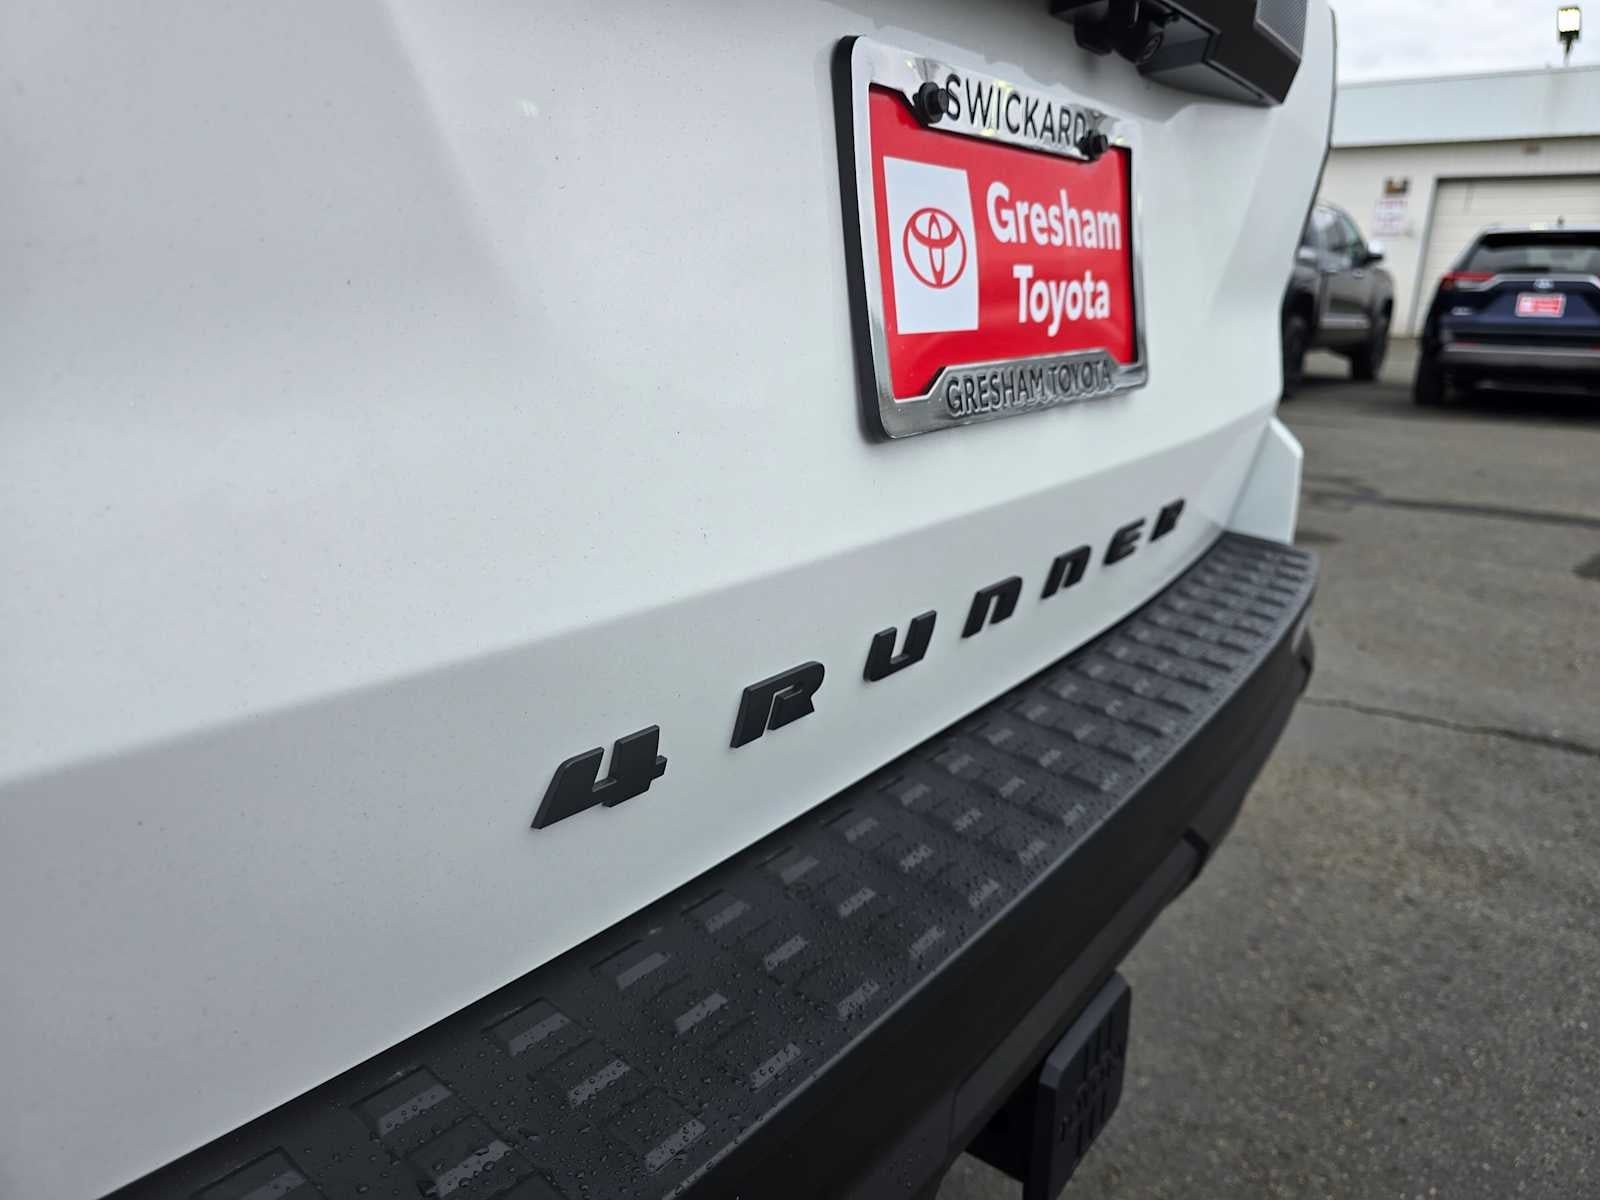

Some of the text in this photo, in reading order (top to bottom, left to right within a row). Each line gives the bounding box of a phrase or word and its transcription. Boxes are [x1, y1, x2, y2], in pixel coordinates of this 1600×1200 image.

[945, 73, 1087, 149] SWICKARD
[986, 181, 1121, 251] Gresham
[1013, 264, 1110, 337] Toyota
[946, 359, 1112, 414] GRESHAM TOYOTA
